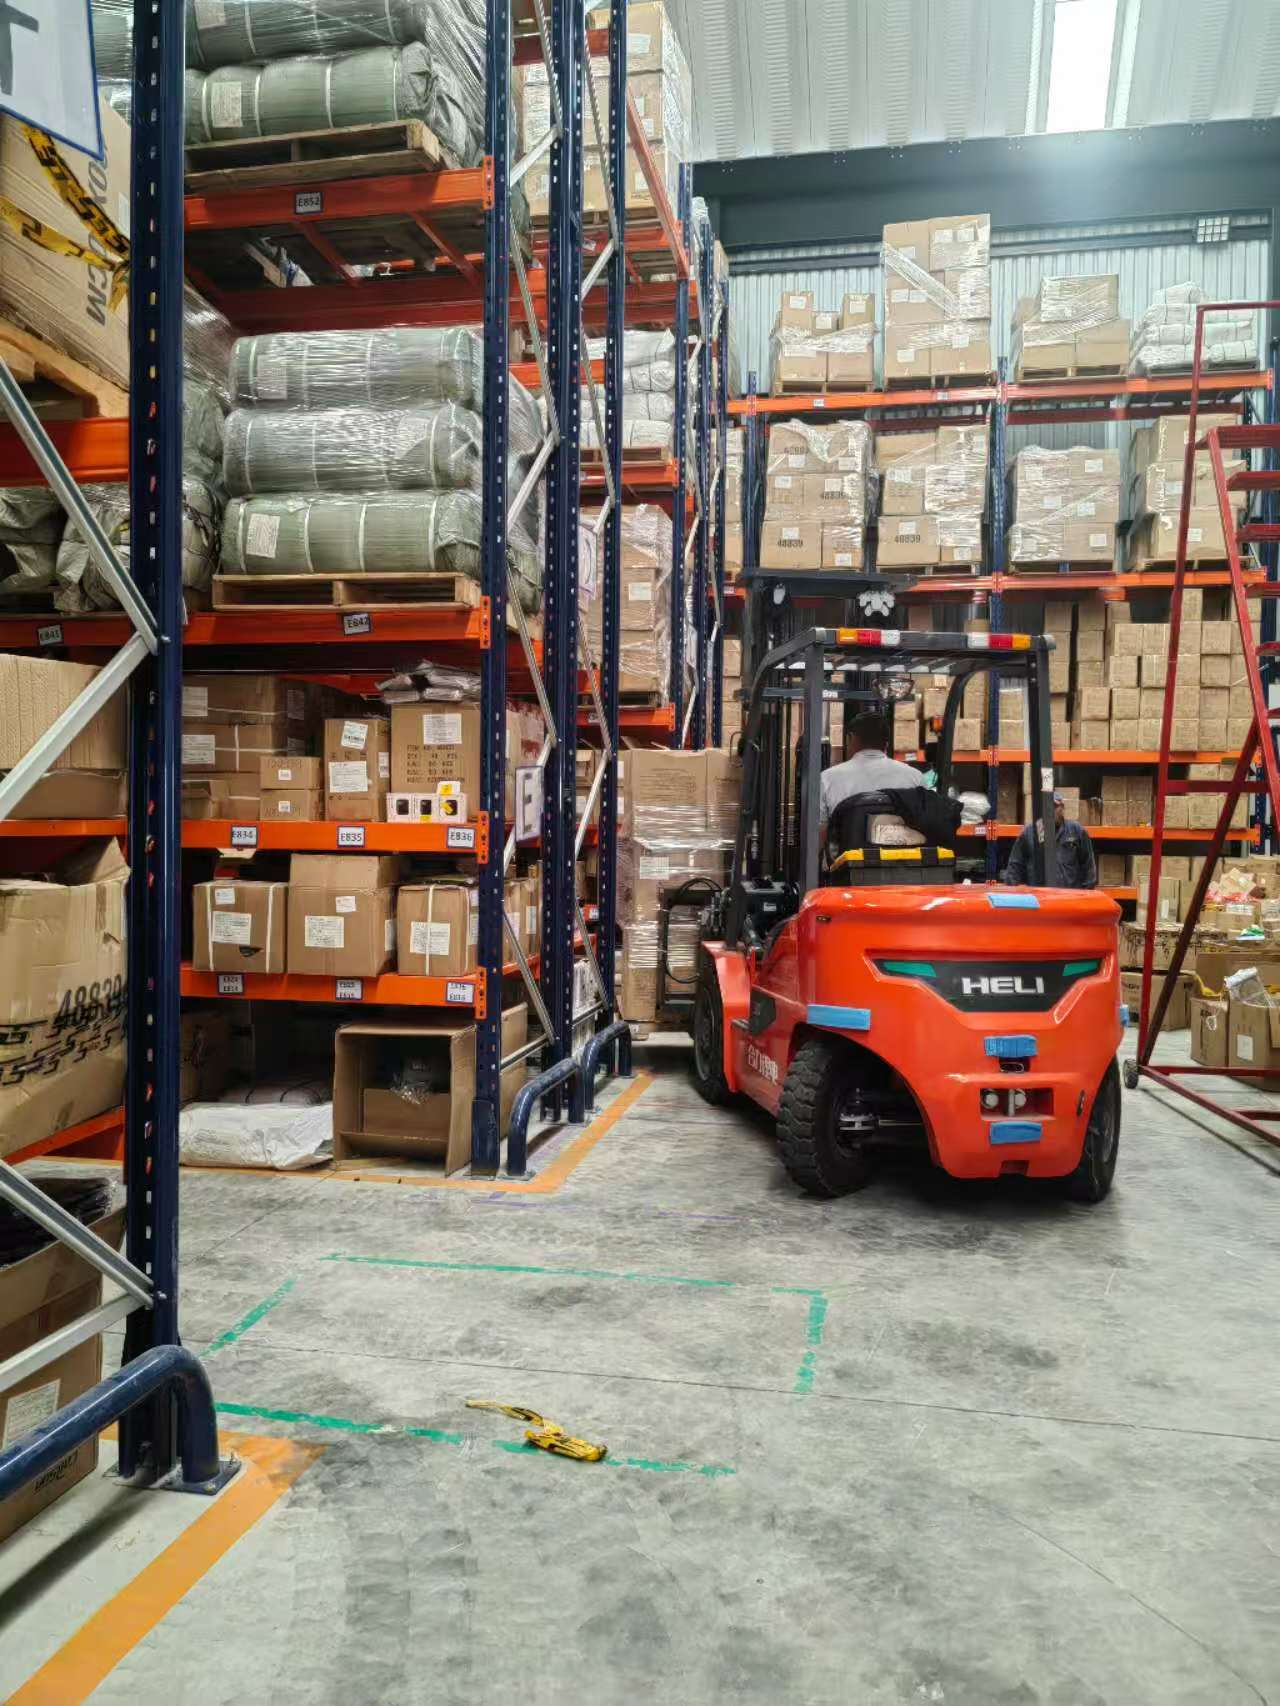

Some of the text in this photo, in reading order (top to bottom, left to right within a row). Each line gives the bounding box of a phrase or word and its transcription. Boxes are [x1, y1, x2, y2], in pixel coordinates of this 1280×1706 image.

[298, 197, 321, 207] E852
[341, 832, 363, 842] E835
[450, 831, 473, 842] E836
[961, 976, 1045, 995] HELI
